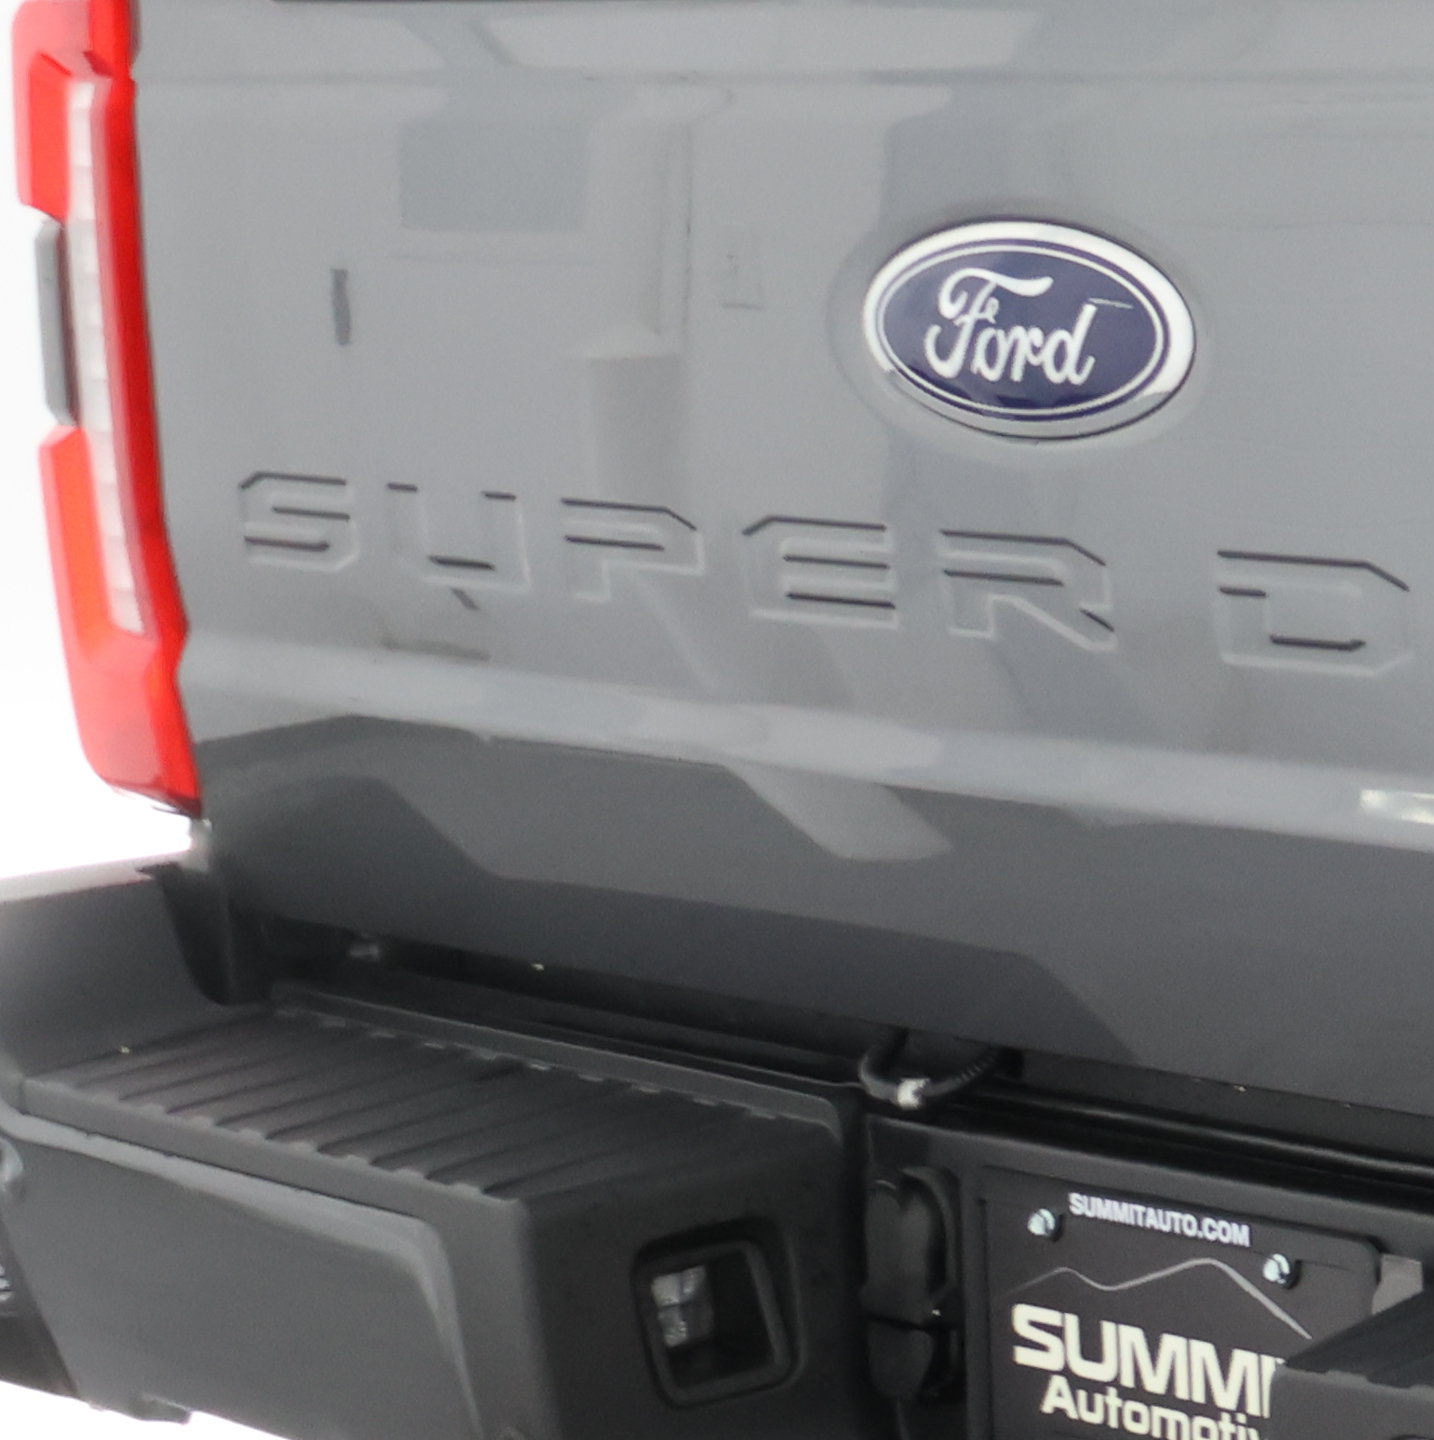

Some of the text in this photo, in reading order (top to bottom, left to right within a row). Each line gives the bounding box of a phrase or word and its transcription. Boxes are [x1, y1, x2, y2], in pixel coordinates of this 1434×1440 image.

[923, 267, 1098, 386] Ford
[238, 471, 1118, 653] SUPER
[1068, 1192, 1251, 1248] SUMMITAUTO.COM
[1011, 1303, 1287, 1419] SUMMI
